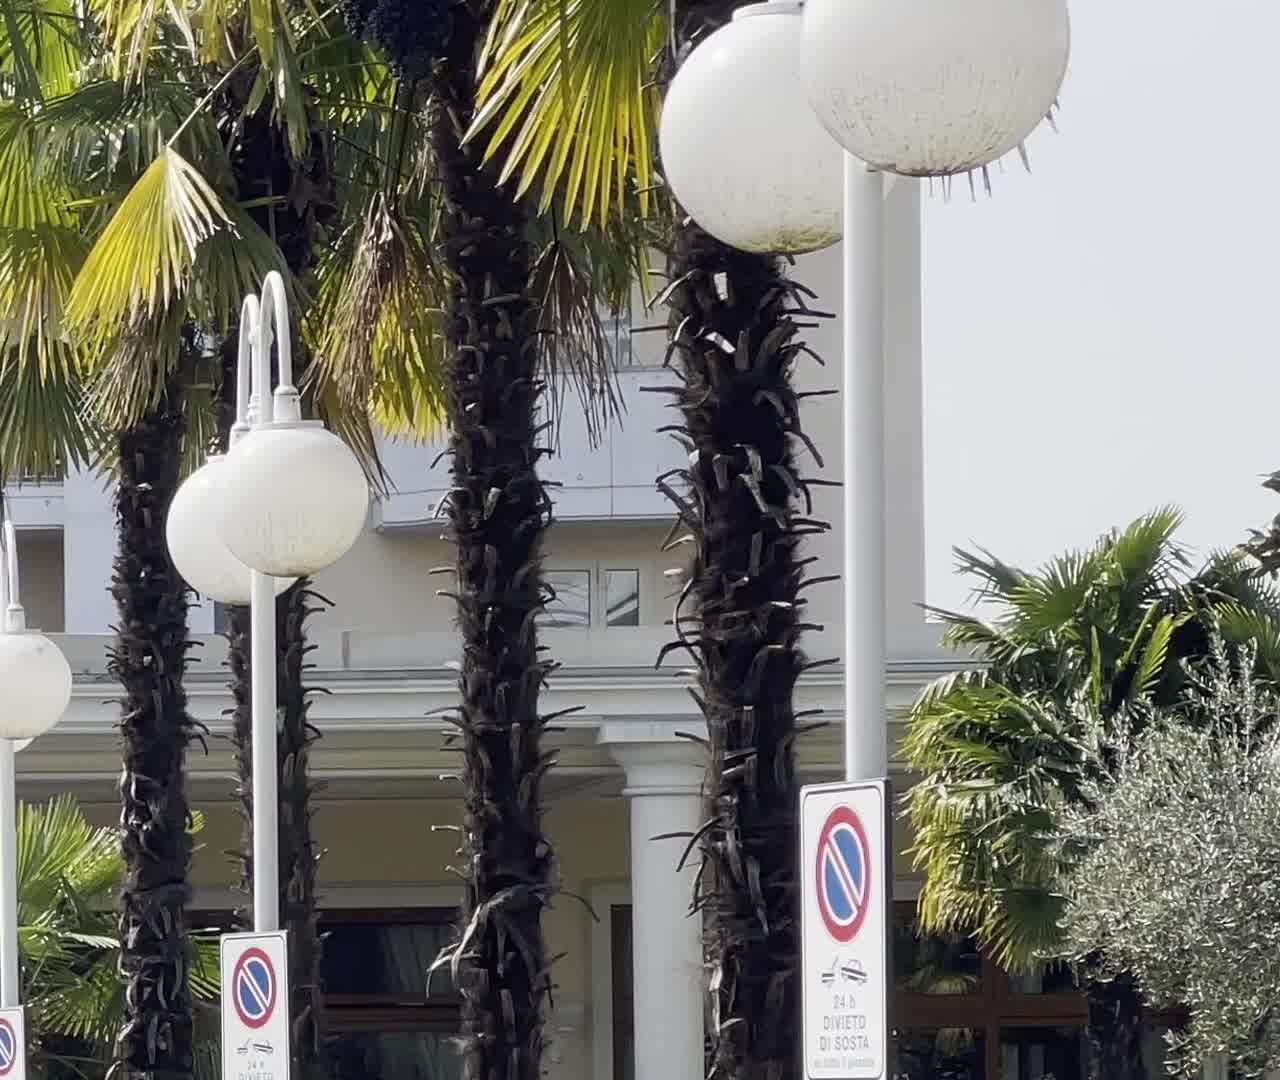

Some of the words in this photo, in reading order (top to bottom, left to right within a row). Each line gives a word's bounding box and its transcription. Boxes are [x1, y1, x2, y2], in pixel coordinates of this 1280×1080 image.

[823, 1015, 867, 1031] DIVIETO
[819, 1035, 832, 1052] DI
[834, 1034, 870, 1051] SOSTA
